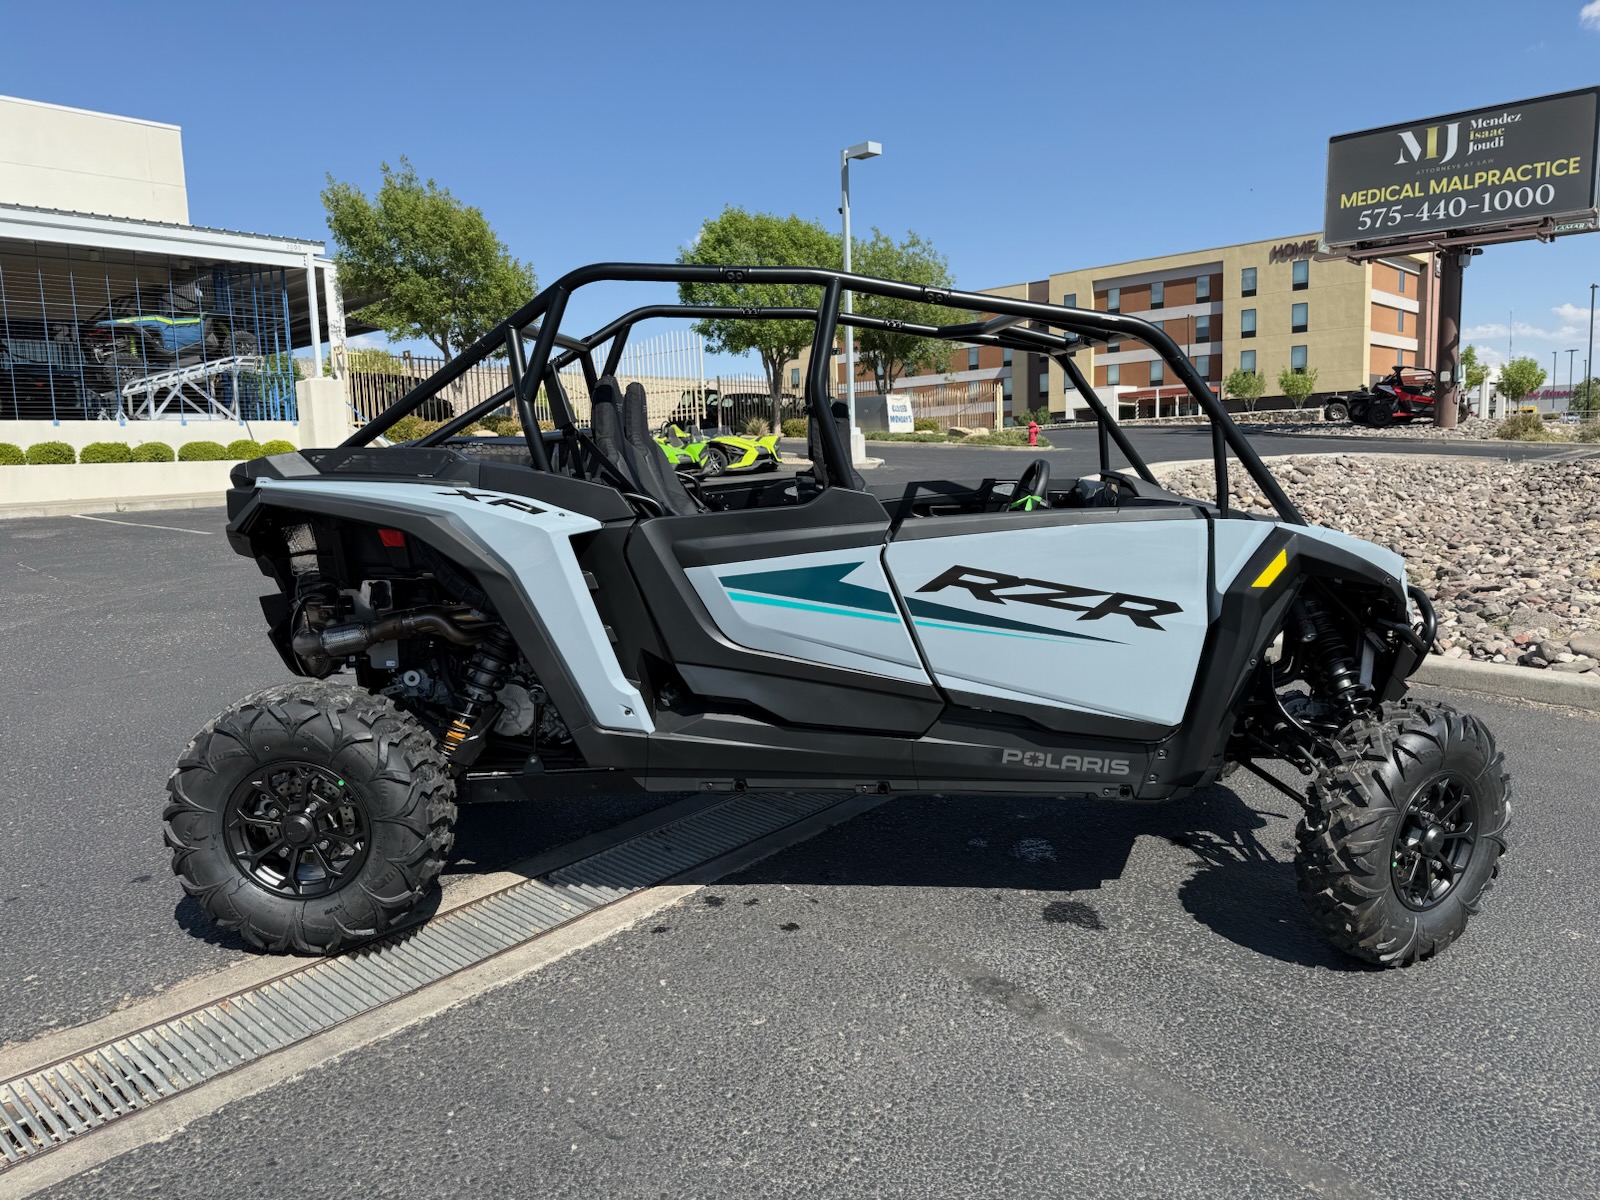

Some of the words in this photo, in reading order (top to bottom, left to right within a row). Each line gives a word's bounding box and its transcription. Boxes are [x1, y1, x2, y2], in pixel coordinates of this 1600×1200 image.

[1470, 113, 1521, 130] Mendez
[1469, 127, 1505, 141] Isaac
[1466, 136, 1504, 156] Joudi
[1416, 163, 1461, 175] ATTORNEYS
[1477, 157, 1495, 166] LAW
[1340, 182, 1424, 209] MEDICAL
[1429, 156, 1581, 195] MALPRACTICE
[1357, 183, 1555, 231] 575-440-1000
[1555, 222, 1585, 231] LAMAR
[1271, 239, 1317, 261] HOME
[431, 489, 548, 514] XP
[914, 564, 1184, 632] RZR
[1001, 749, 1130, 775] POLARIS
